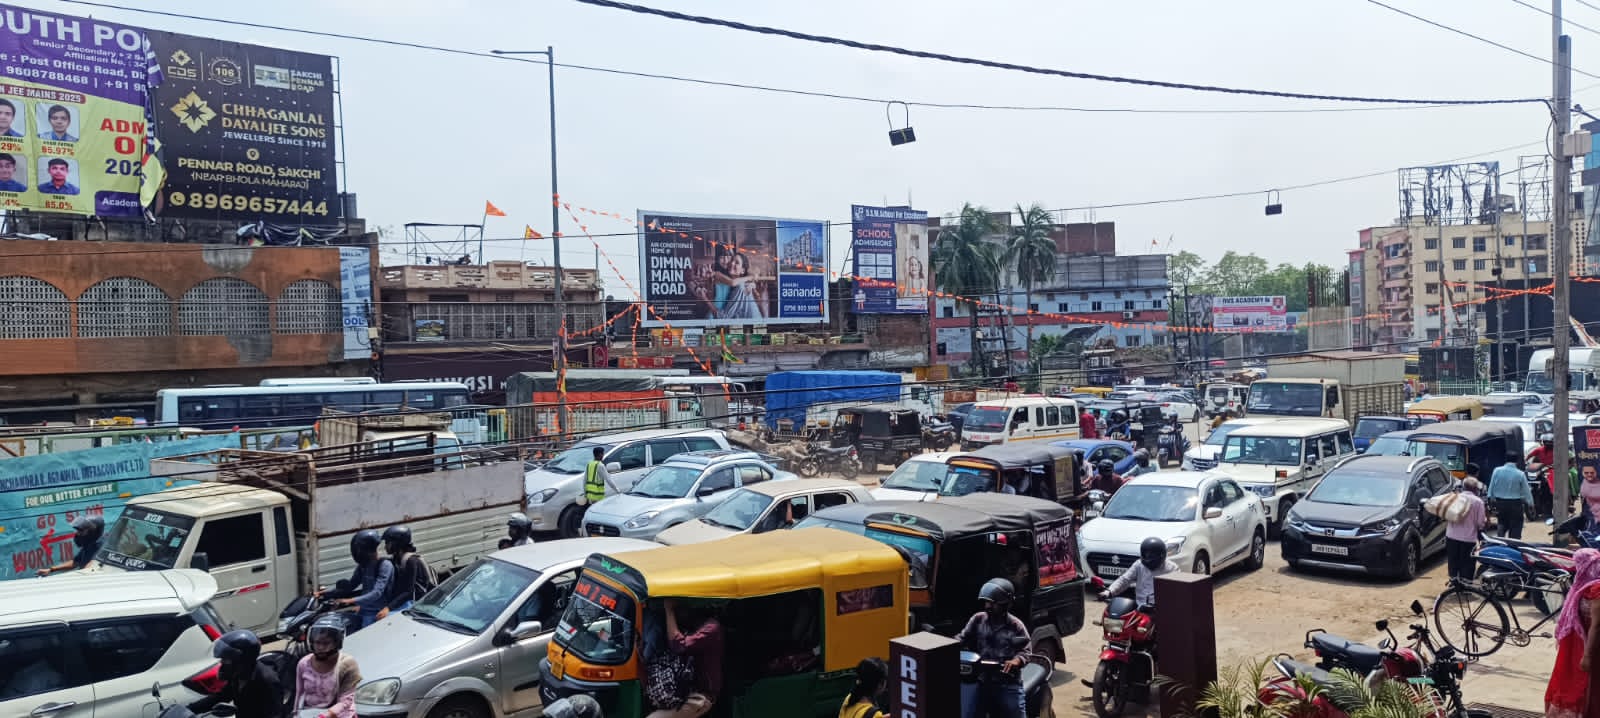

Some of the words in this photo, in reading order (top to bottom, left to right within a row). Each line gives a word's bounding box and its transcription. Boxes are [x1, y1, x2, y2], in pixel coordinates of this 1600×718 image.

[64, 51, 108, 63] Affiliation
[67, 44, 116, 58] Secondary
[20, 55, 49, 66] Post
[53, 59, 90, 72] Office
[8, 87, 25, 96] JEE
[26, 89, 57, 99] MAINS
[222, 103, 325, 125] CHHAGANLAL
[222, 117, 288, 135] DAYALJEE
[291, 125, 326, 138] SONS
[222, 131, 276, 144] JEWELLERS
[278, 135, 303, 146] SINCE
[178, 157, 234, 172] PENNAR
[236, 162, 276, 178] ROAD,
[278, 167, 321, 179] SAKCHI
[226, 175, 260, 185] BHOLA
[189, 192, 328, 217] 8969657444
[857, 229, 891, 239] SCHOOL
[651, 256, 692, 269] DIMNA
[651, 270, 684, 282] MAIN
[651, 282, 686, 296] ROAD
[26, 497, 39, 507] FOR
[40, 494, 53, 505] OUR
[55, 490, 82, 502] BETTER
[83, 484, 113, 497] FUTURE
[37, 514, 56, 529] GO
[60, 542, 74, 562] IN
